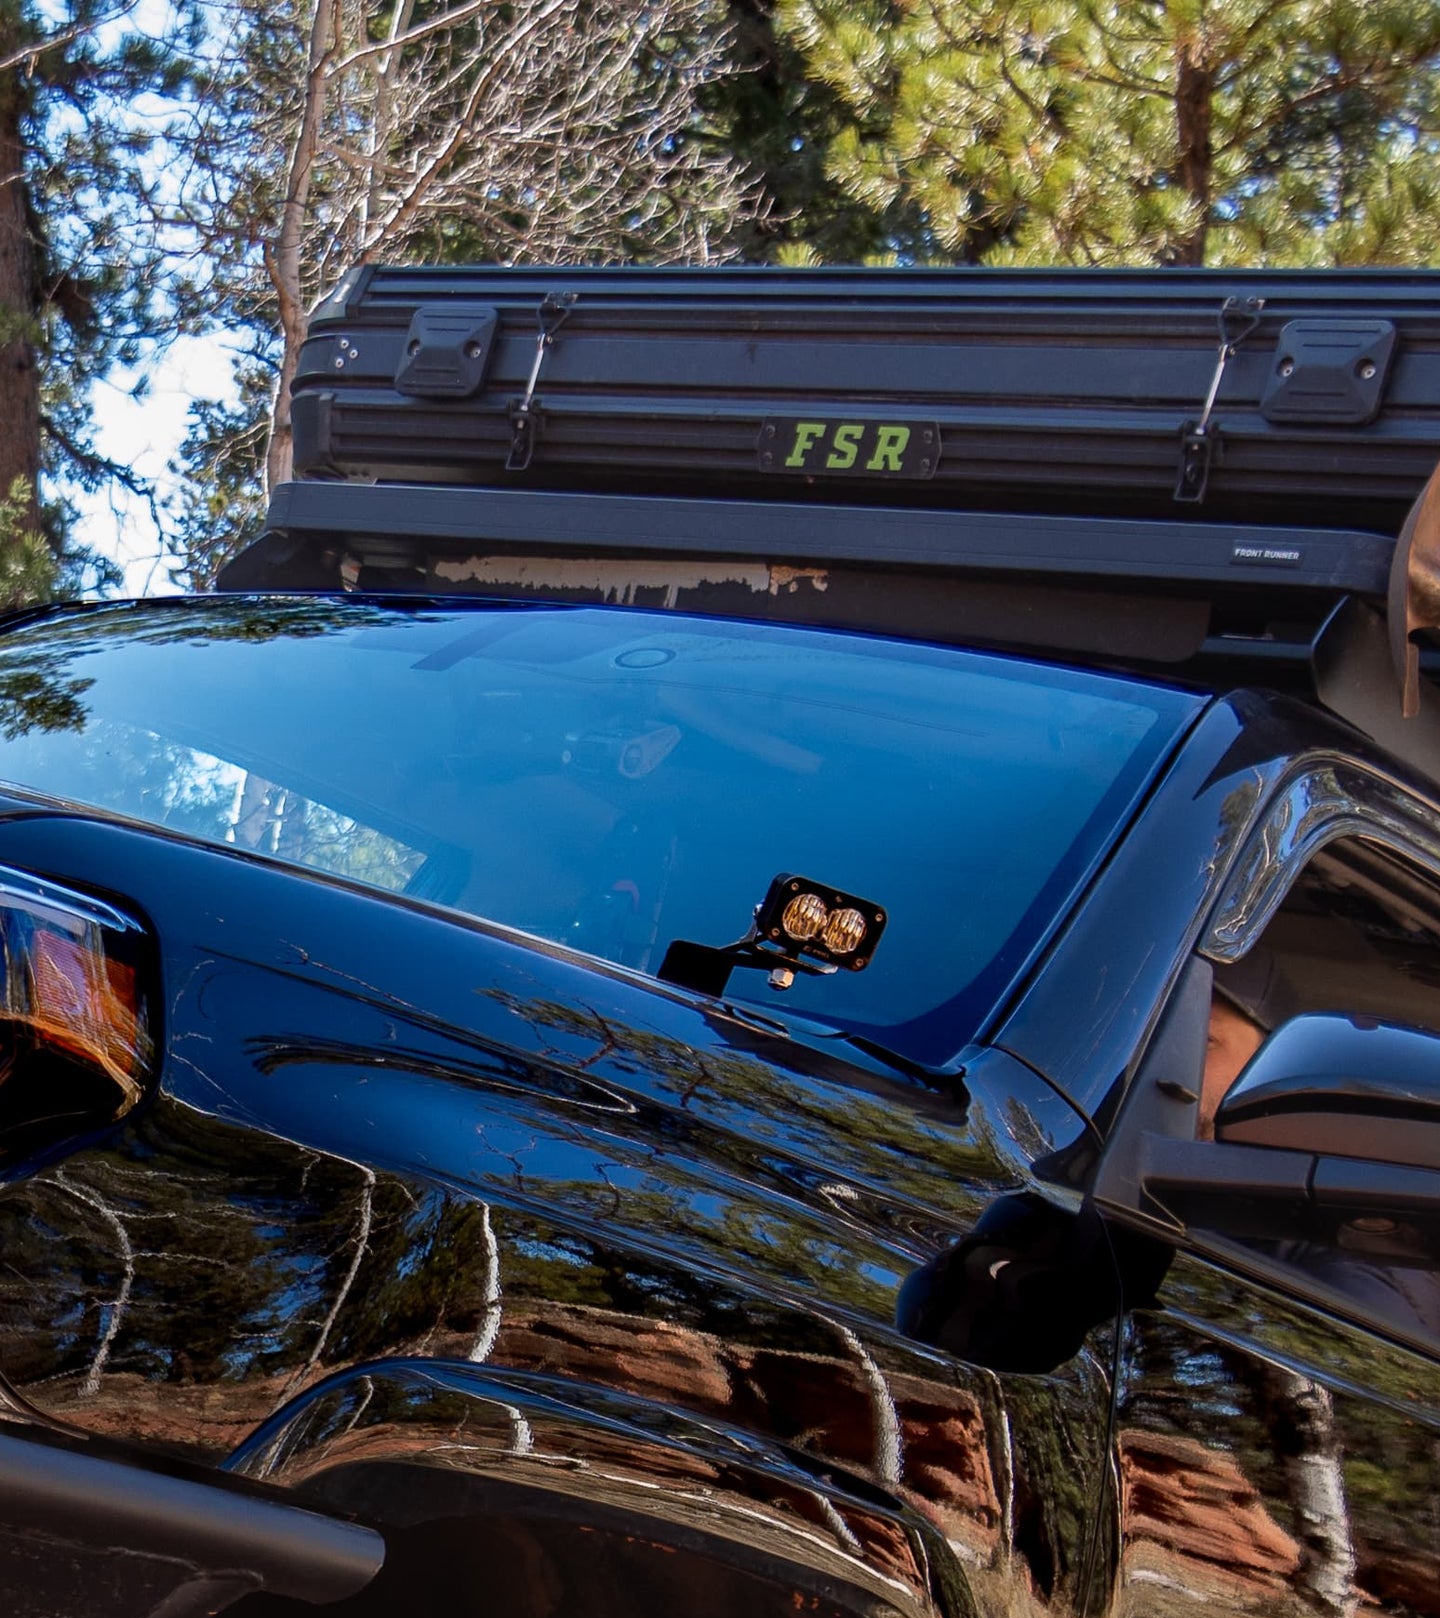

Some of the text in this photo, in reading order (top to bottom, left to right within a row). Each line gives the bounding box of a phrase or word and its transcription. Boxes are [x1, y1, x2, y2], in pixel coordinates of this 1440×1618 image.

[784, 422, 911, 471] FSR
[1234, 547, 1300, 561] FRONT RUNNER
